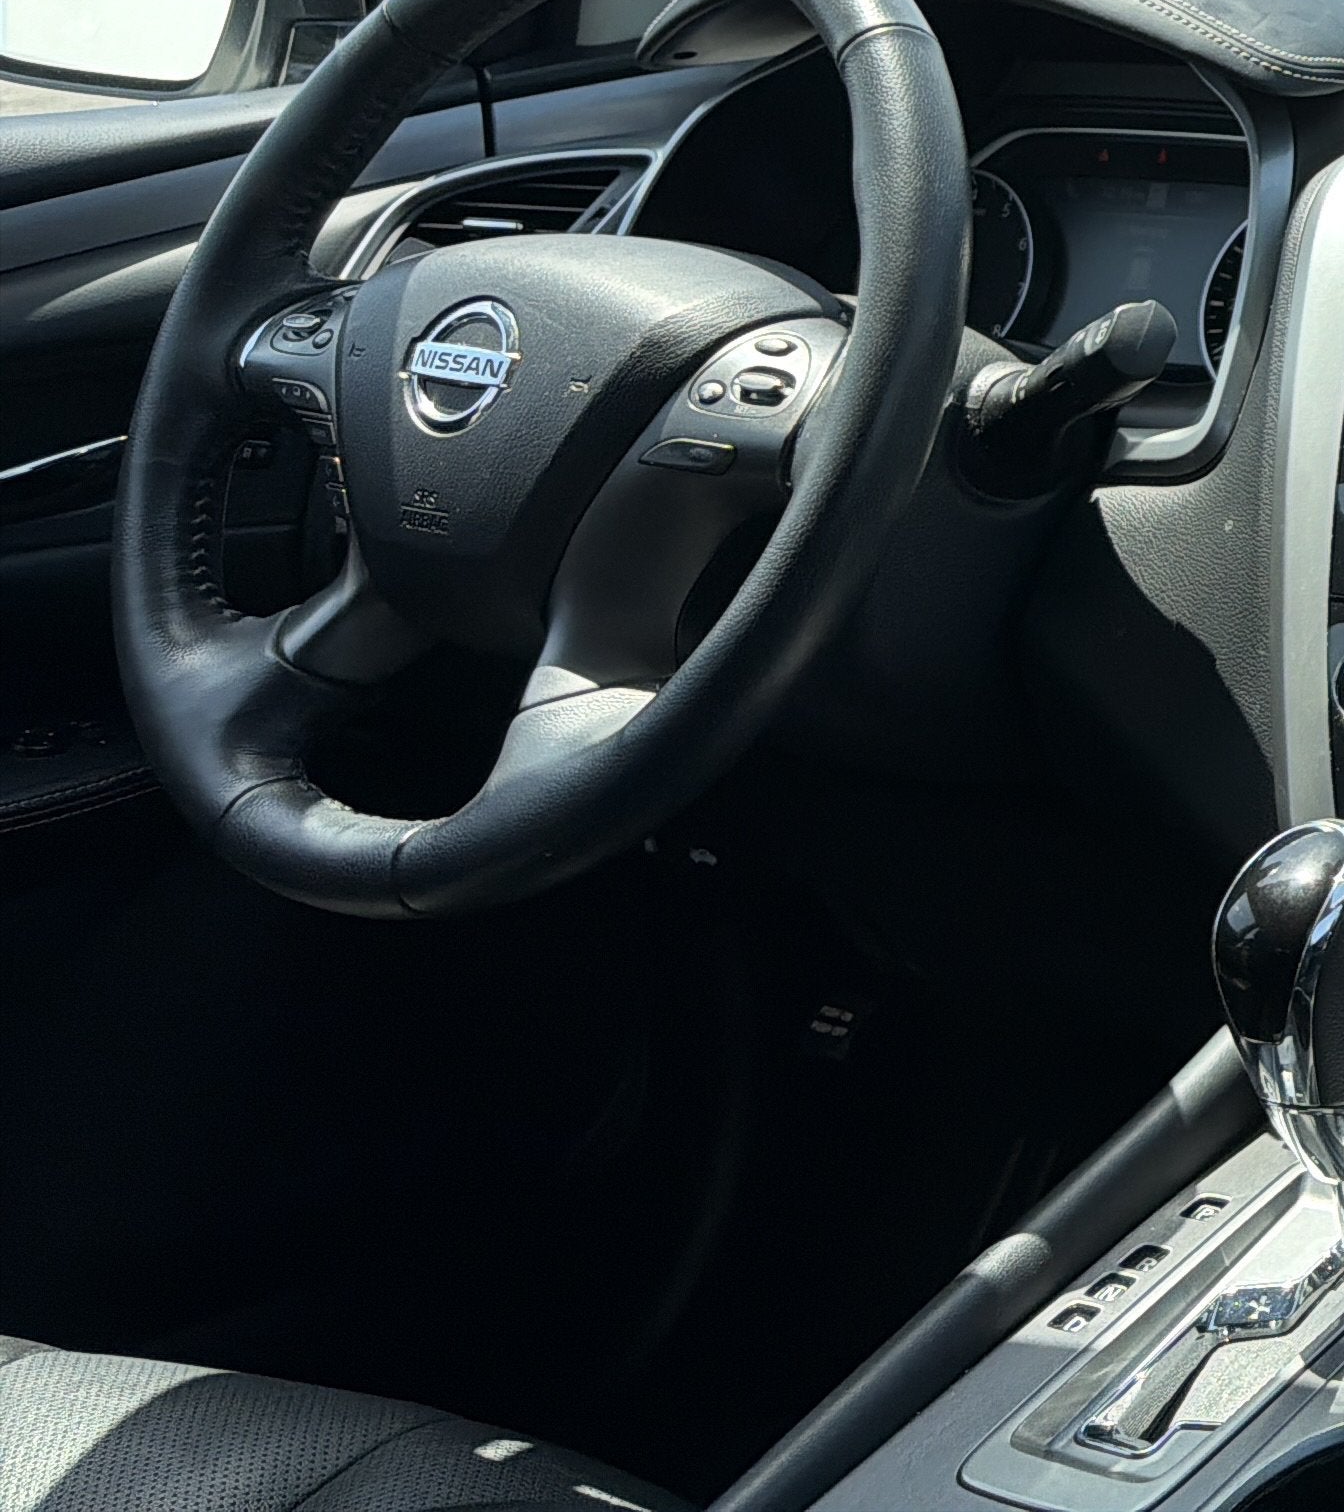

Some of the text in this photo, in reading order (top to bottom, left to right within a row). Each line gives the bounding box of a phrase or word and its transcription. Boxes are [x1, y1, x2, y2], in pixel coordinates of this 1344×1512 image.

[1002, 203, 1011, 218] 5
[414, 348, 504, 379] NISSAN
[413, 488, 440, 507] SRS
[1136, 1257, 1158, 1272] R
[1095, 1284, 1127, 1302] N
